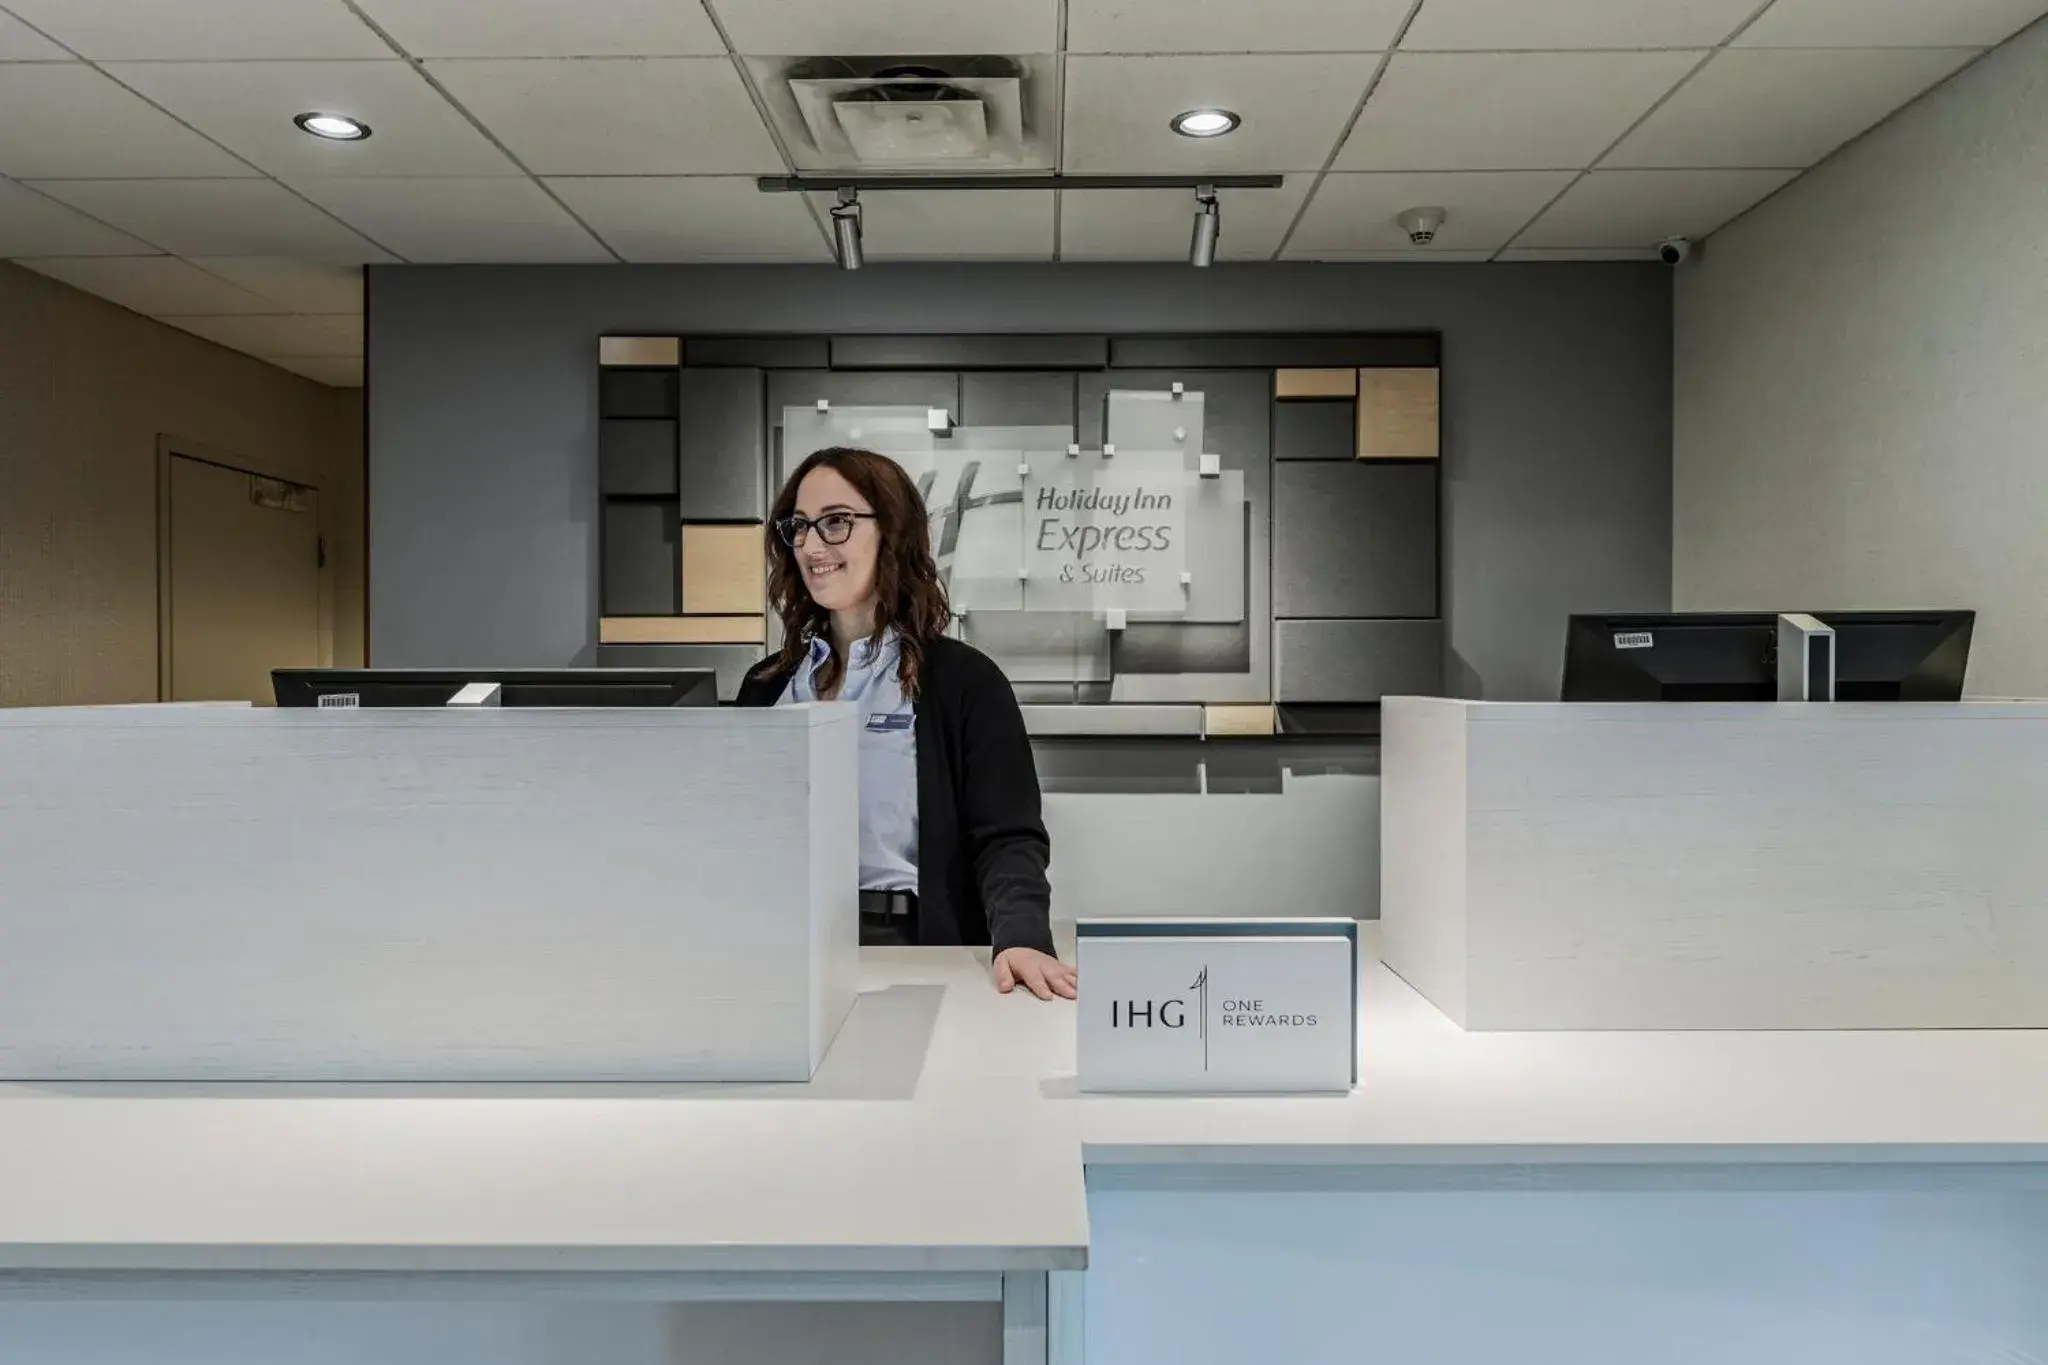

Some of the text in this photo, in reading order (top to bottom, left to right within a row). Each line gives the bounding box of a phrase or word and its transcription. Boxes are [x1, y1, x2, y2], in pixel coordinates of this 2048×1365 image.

[1037, 487, 1172, 516] Holiday Inn
[1037, 518, 1172, 560] Express
[1059, 563, 1145, 584] & Suites
[1112, 1000, 1185, 1028] IHG
[1222, 1000, 1264, 1012] ONE
[1222, 1014, 1318, 1027] REWARDS
